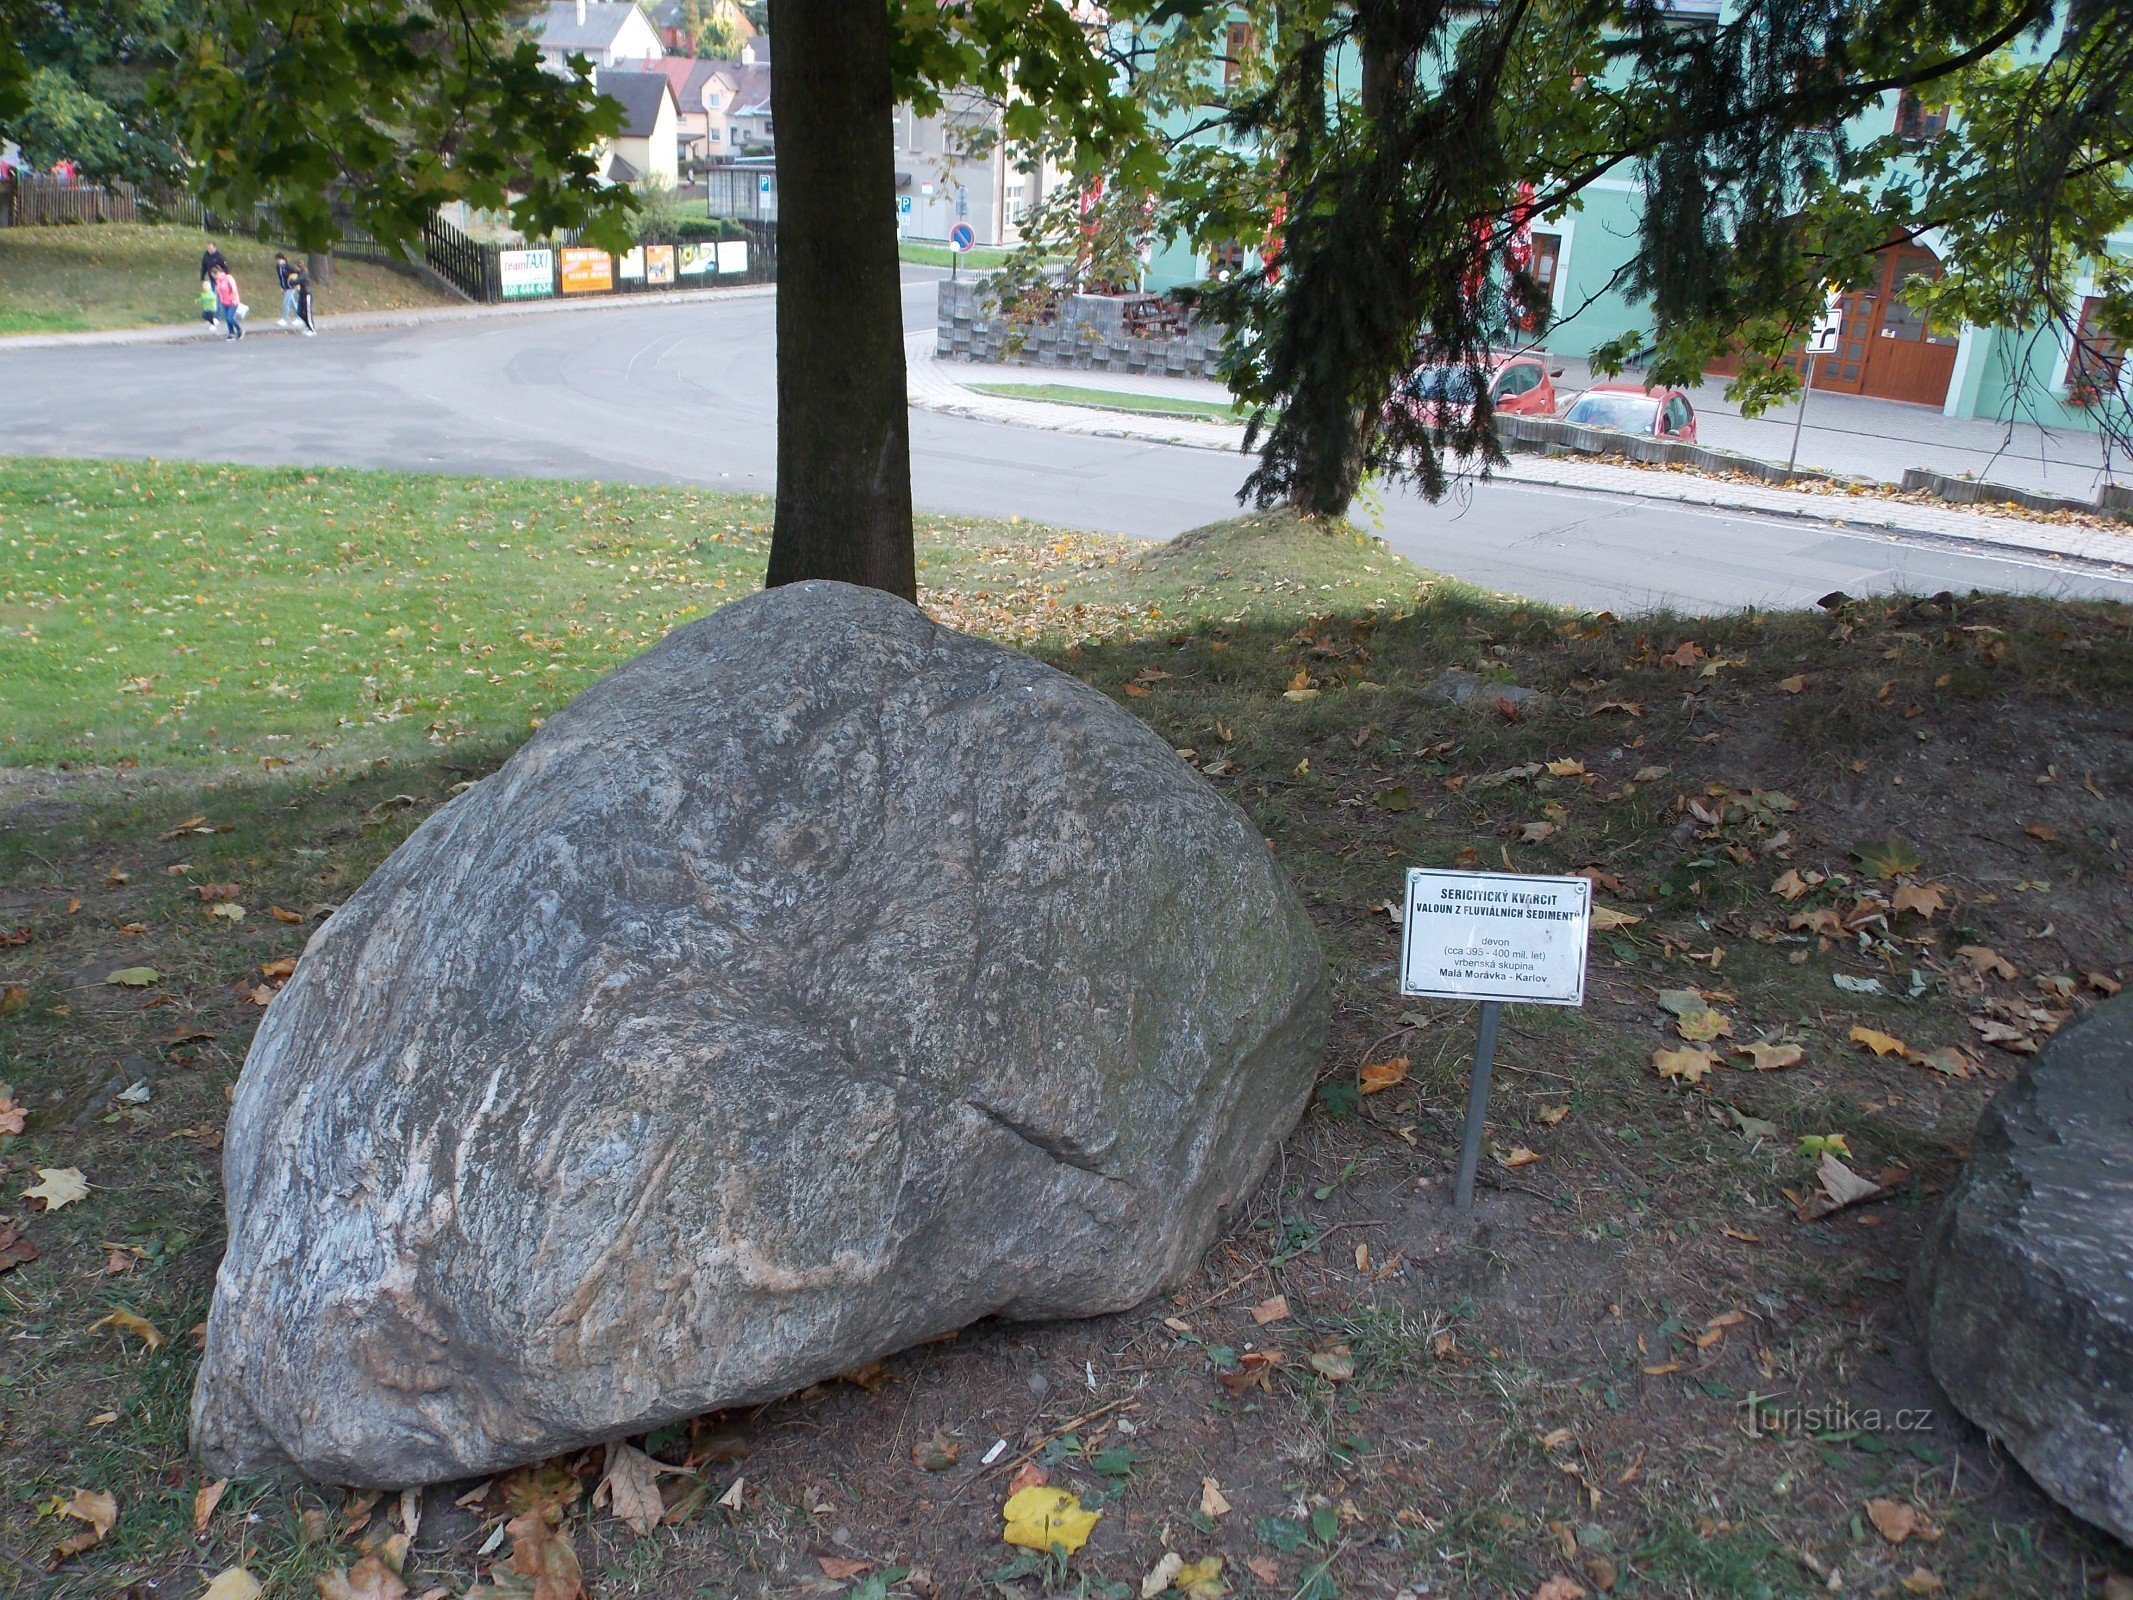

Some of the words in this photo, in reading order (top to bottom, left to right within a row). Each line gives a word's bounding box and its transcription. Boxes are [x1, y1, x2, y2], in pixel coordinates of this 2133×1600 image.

[1440, 888, 1509, 903] SERICITICKÝ
[1511, 893, 1557, 906] KVARCIT
[1416, 903, 1453, 914] VALOUN
[1455, 905, 1461, 915] Z
[1463, 905, 1523, 918] FLUVIÁLNÍCH
[1481, 936, 1510, 947] devon
[1444, 945, 1464, 956] (cca
[1466, 947, 1484, 957] 395
[1492, 948, 1510, 958] 400
[1512, 950, 1528, 960] mil.
[1531, 950, 1546, 961] let)
[1454, 958, 1496, 969] vrbenská
[1498, 961, 1534, 972] skupina
[1439, 968, 1462, 978] Malá
[1465, 969, 1506, 981] Morávka
[1515, 973, 1548, 983] Karlov
